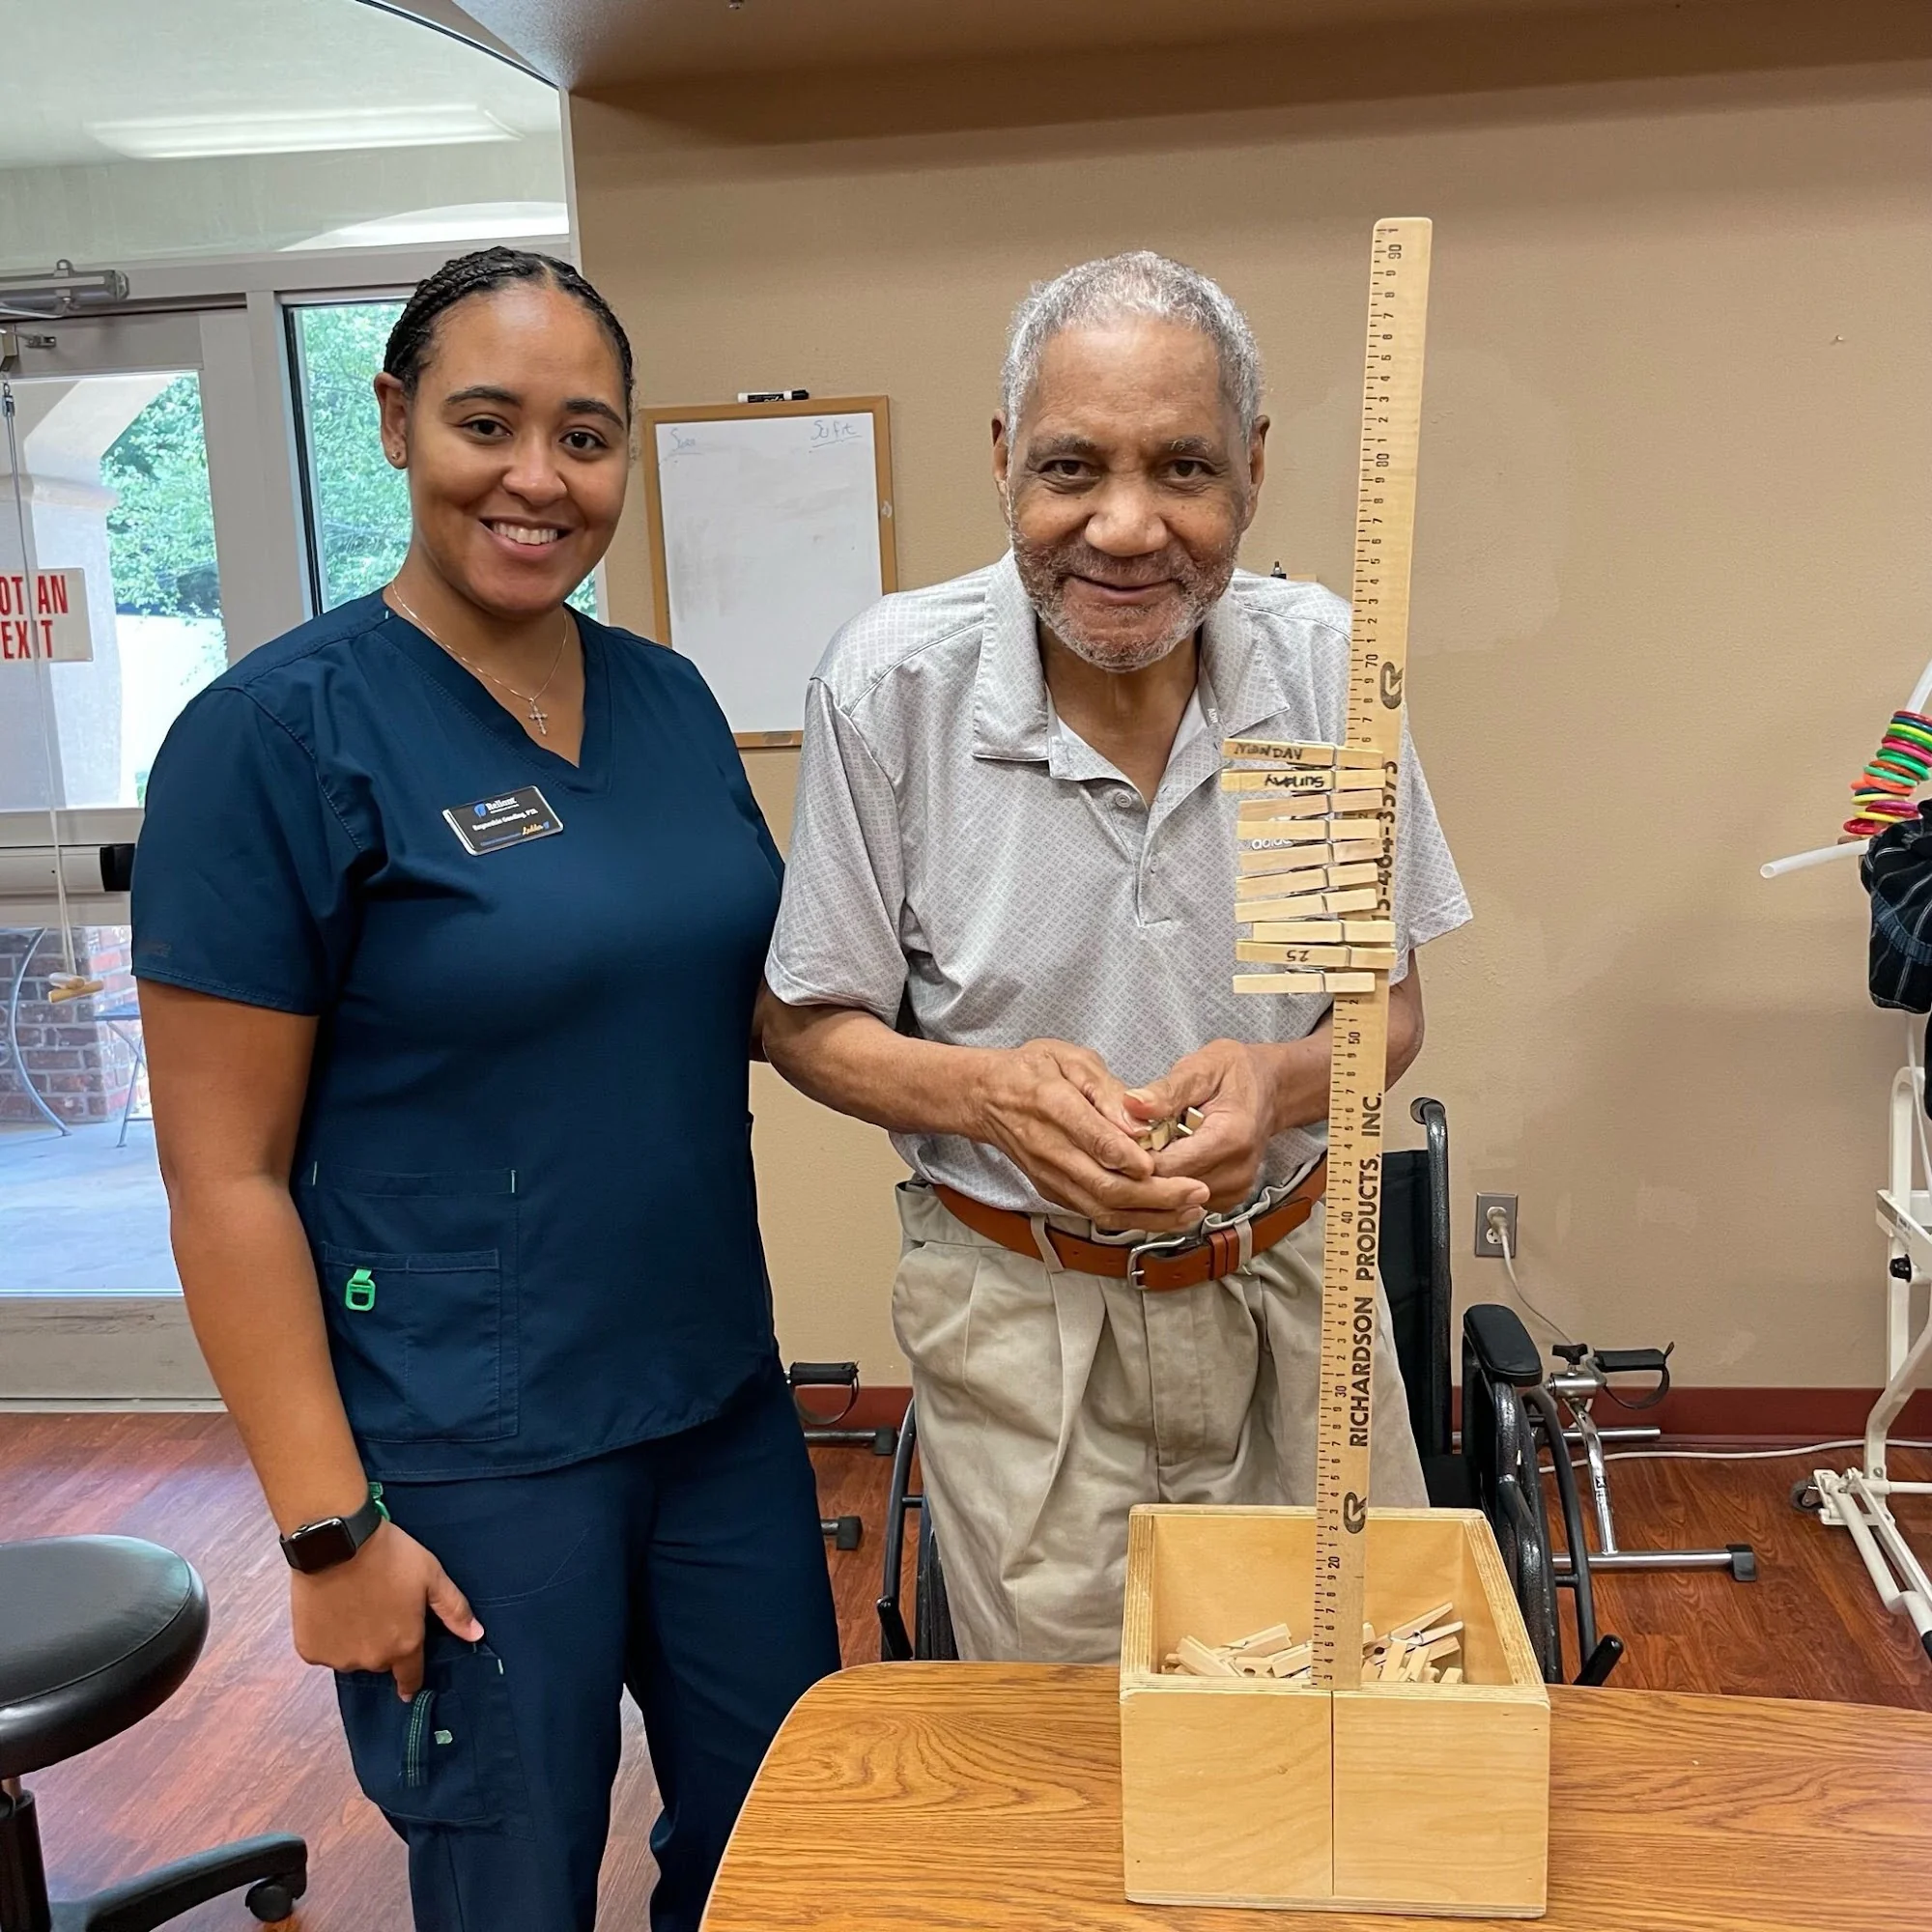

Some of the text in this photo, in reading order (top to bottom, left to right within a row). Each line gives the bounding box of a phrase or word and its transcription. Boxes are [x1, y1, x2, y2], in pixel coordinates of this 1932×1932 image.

[38, 575, 69, 614] AN
[1365, 653, 1378, 668] 70
[1388, 243, 1402, 260] 90
[1286, 951, 1309, 962] 25
[1327, 1556, 1340, 1569] 20
[1334, 1385, 1348, 1398] 30
[1341, 1211, 1353, 1224] 40
[1348, 1031, 1361, 1044] 50
[1350, 1093, 1382, 1447] RICHARDSON PRODUCTS, INC.
